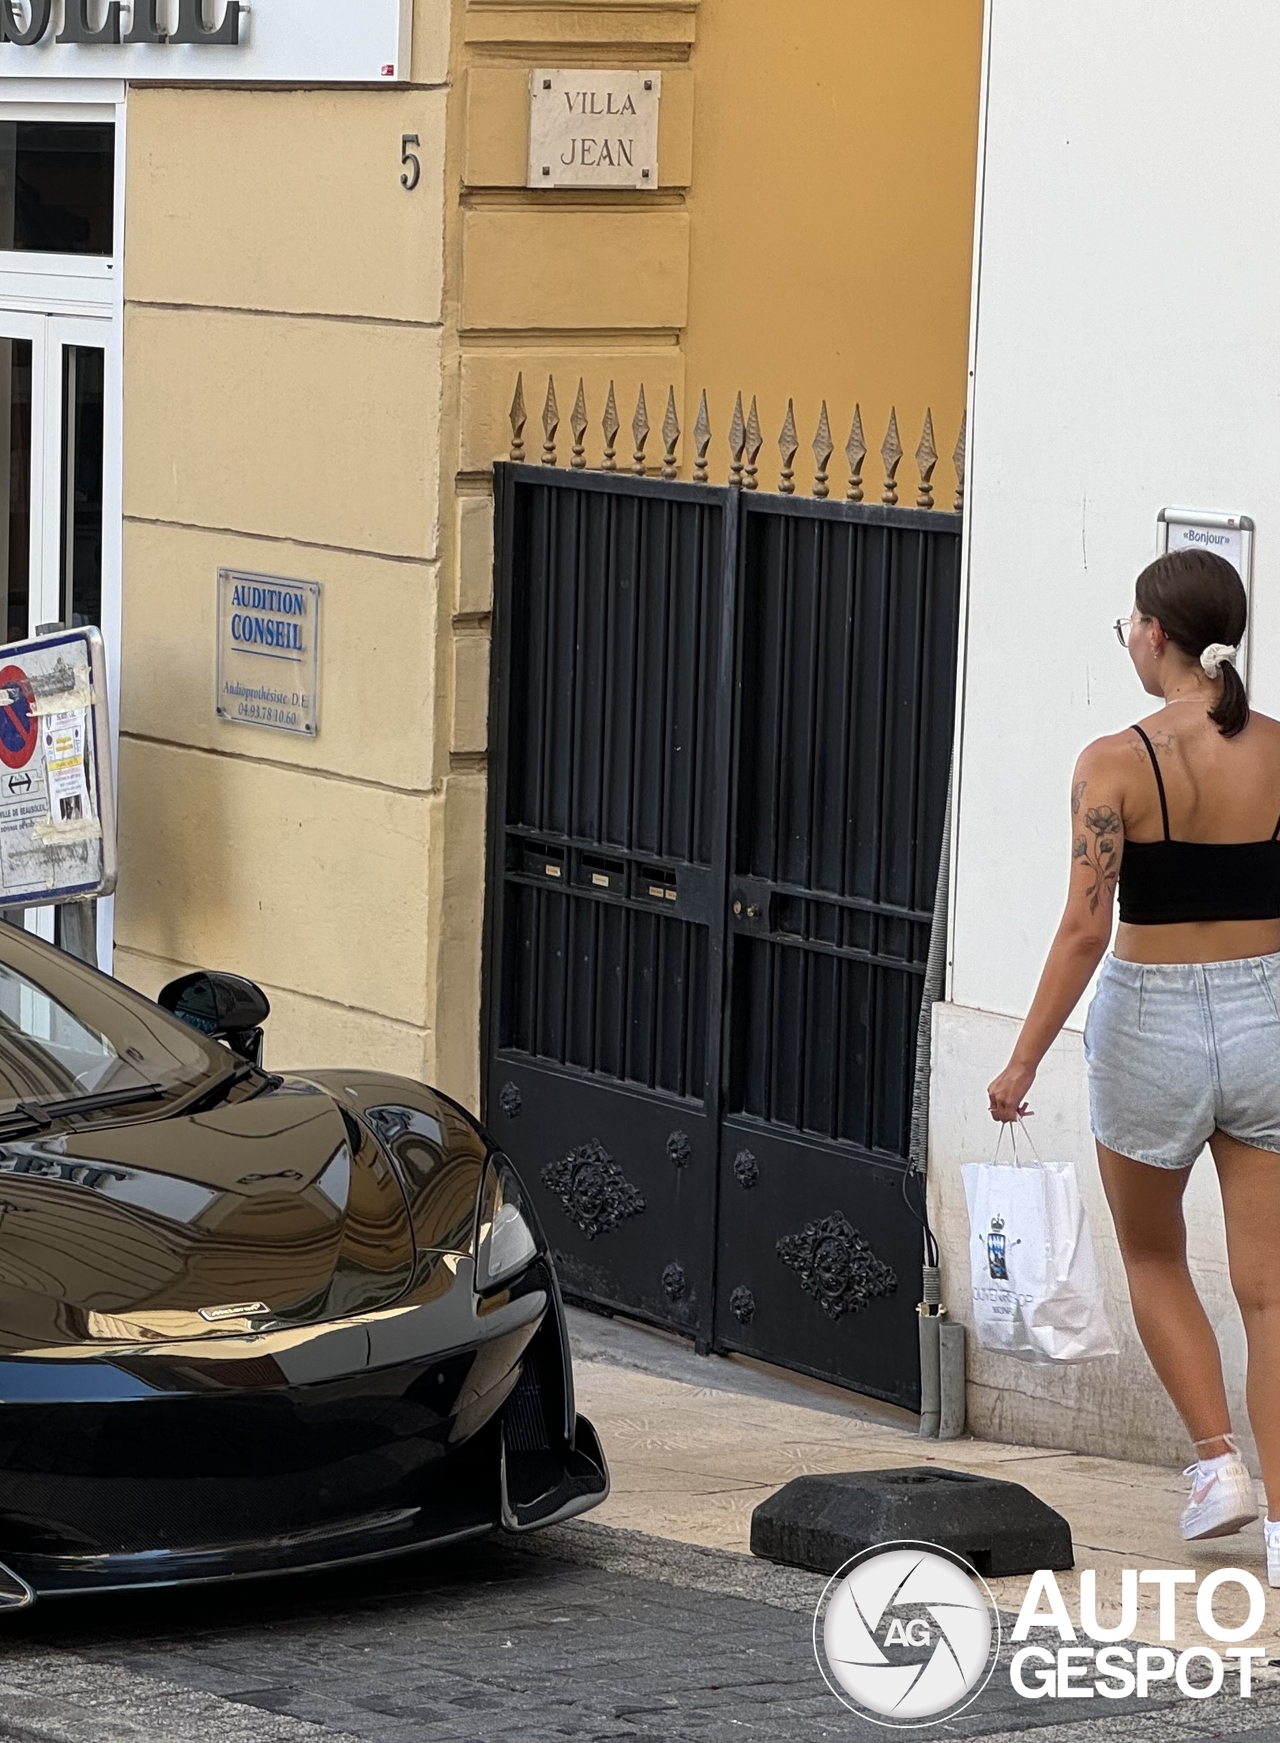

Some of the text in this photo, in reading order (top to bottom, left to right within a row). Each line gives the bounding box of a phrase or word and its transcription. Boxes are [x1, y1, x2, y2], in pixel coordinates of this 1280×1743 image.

[564, 92, 637, 115] VILLA
[400, 134, 420, 190] 5
[560, 138, 634, 167] JEAN
[231, 585, 303, 616] AUDITION
[231, 613, 303, 651] CONSEIL
[12, 808, 19, 816] DE
